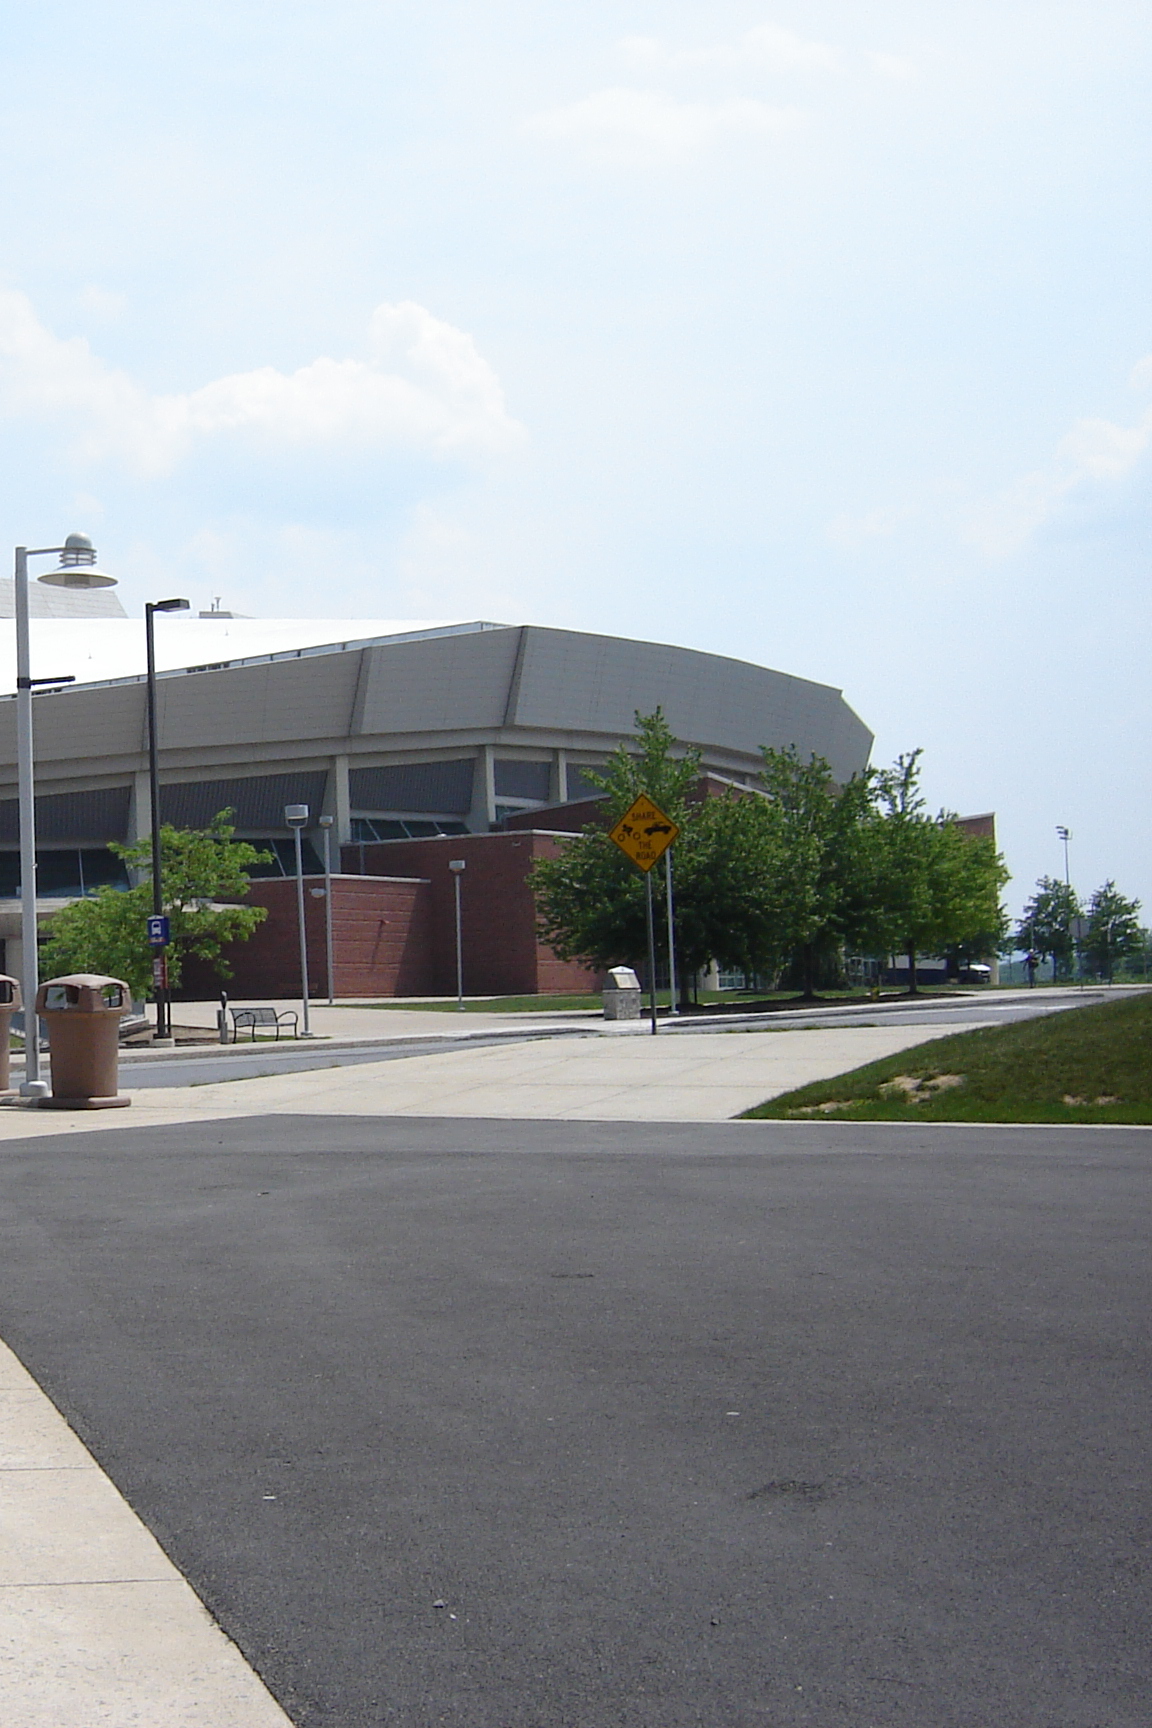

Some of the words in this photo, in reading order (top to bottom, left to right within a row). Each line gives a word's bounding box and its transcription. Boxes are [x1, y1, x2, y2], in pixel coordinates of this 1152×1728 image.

[631, 812, 656, 821] SHARE
[638, 840, 652, 849] THE
[635, 851, 656, 860] ROAD
